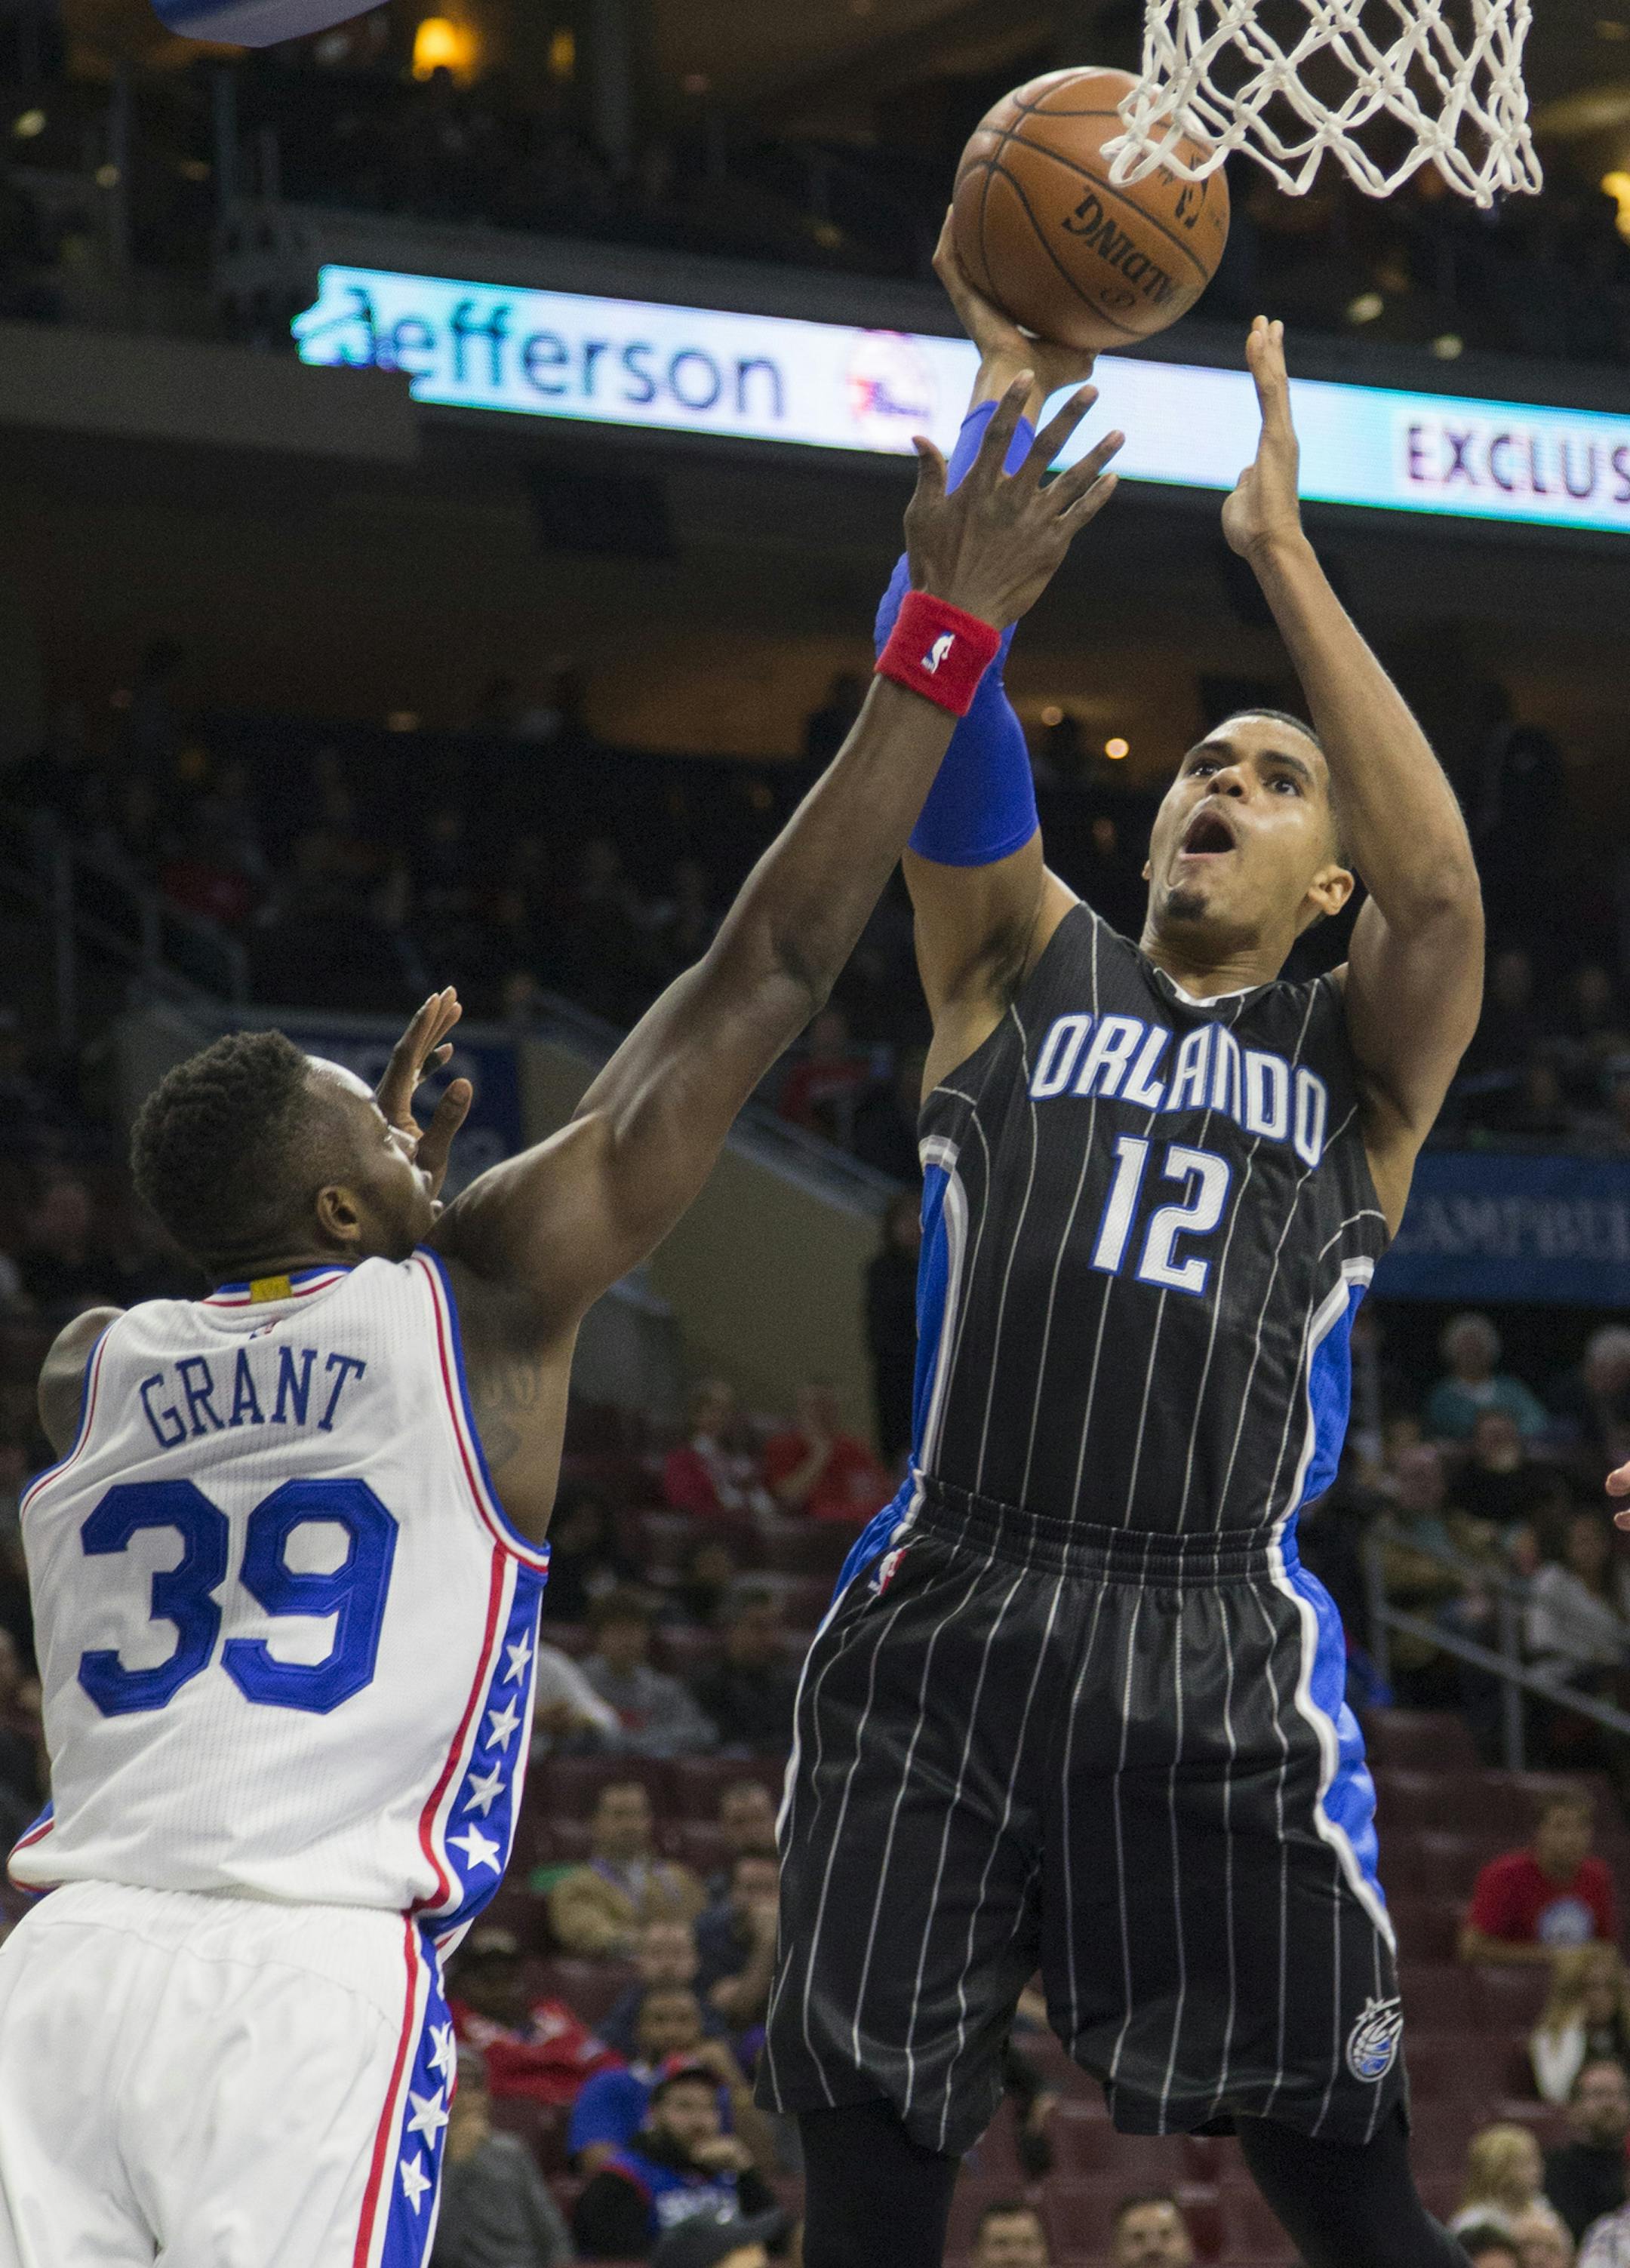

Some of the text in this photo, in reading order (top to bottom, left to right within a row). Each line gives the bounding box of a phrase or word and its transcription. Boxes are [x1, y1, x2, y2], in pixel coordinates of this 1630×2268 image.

[345, 285, 786, 421] Jefferson
[1408, 425, 1630, 502] EXCLUS
[1029, 1012, 1328, 1170] ORLANDO
[1088, 1132, 1232, 1297] 12
[139, 1346, 366, 1449] GRANT
[77, 1477, 400, 1718] 39
